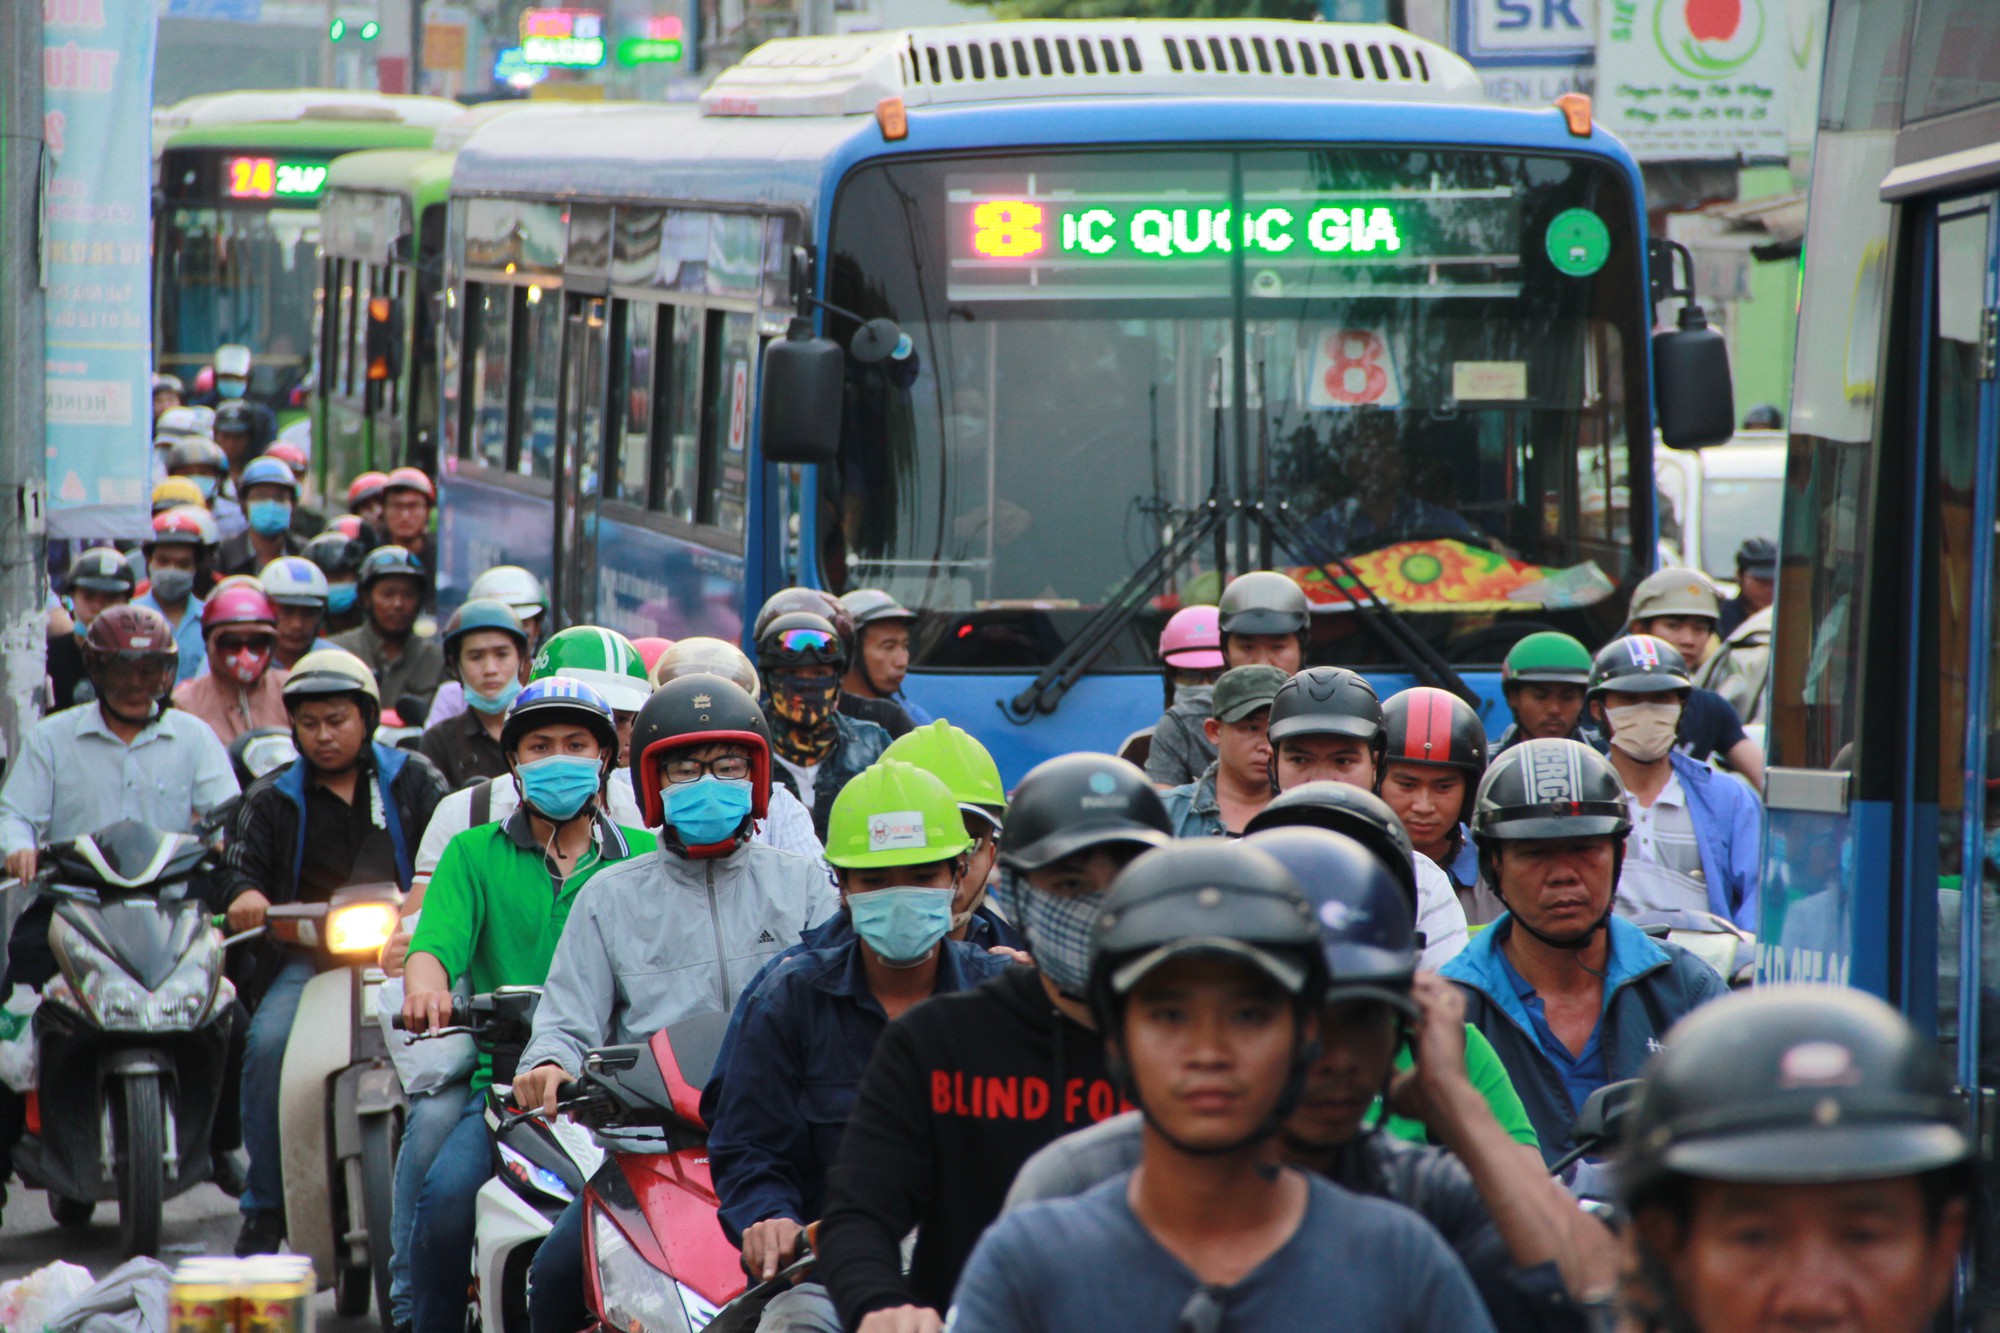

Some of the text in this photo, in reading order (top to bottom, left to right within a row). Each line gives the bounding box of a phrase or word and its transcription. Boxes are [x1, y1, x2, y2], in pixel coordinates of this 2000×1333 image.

[232, 158, 274, 196] 24
[974, 200, 1042, 256] 8
[1307, 207, 1401, 252] GIA
[1324, 330, 1388, 404] 8
[931, 1069, 1050, 1121] BLIND
